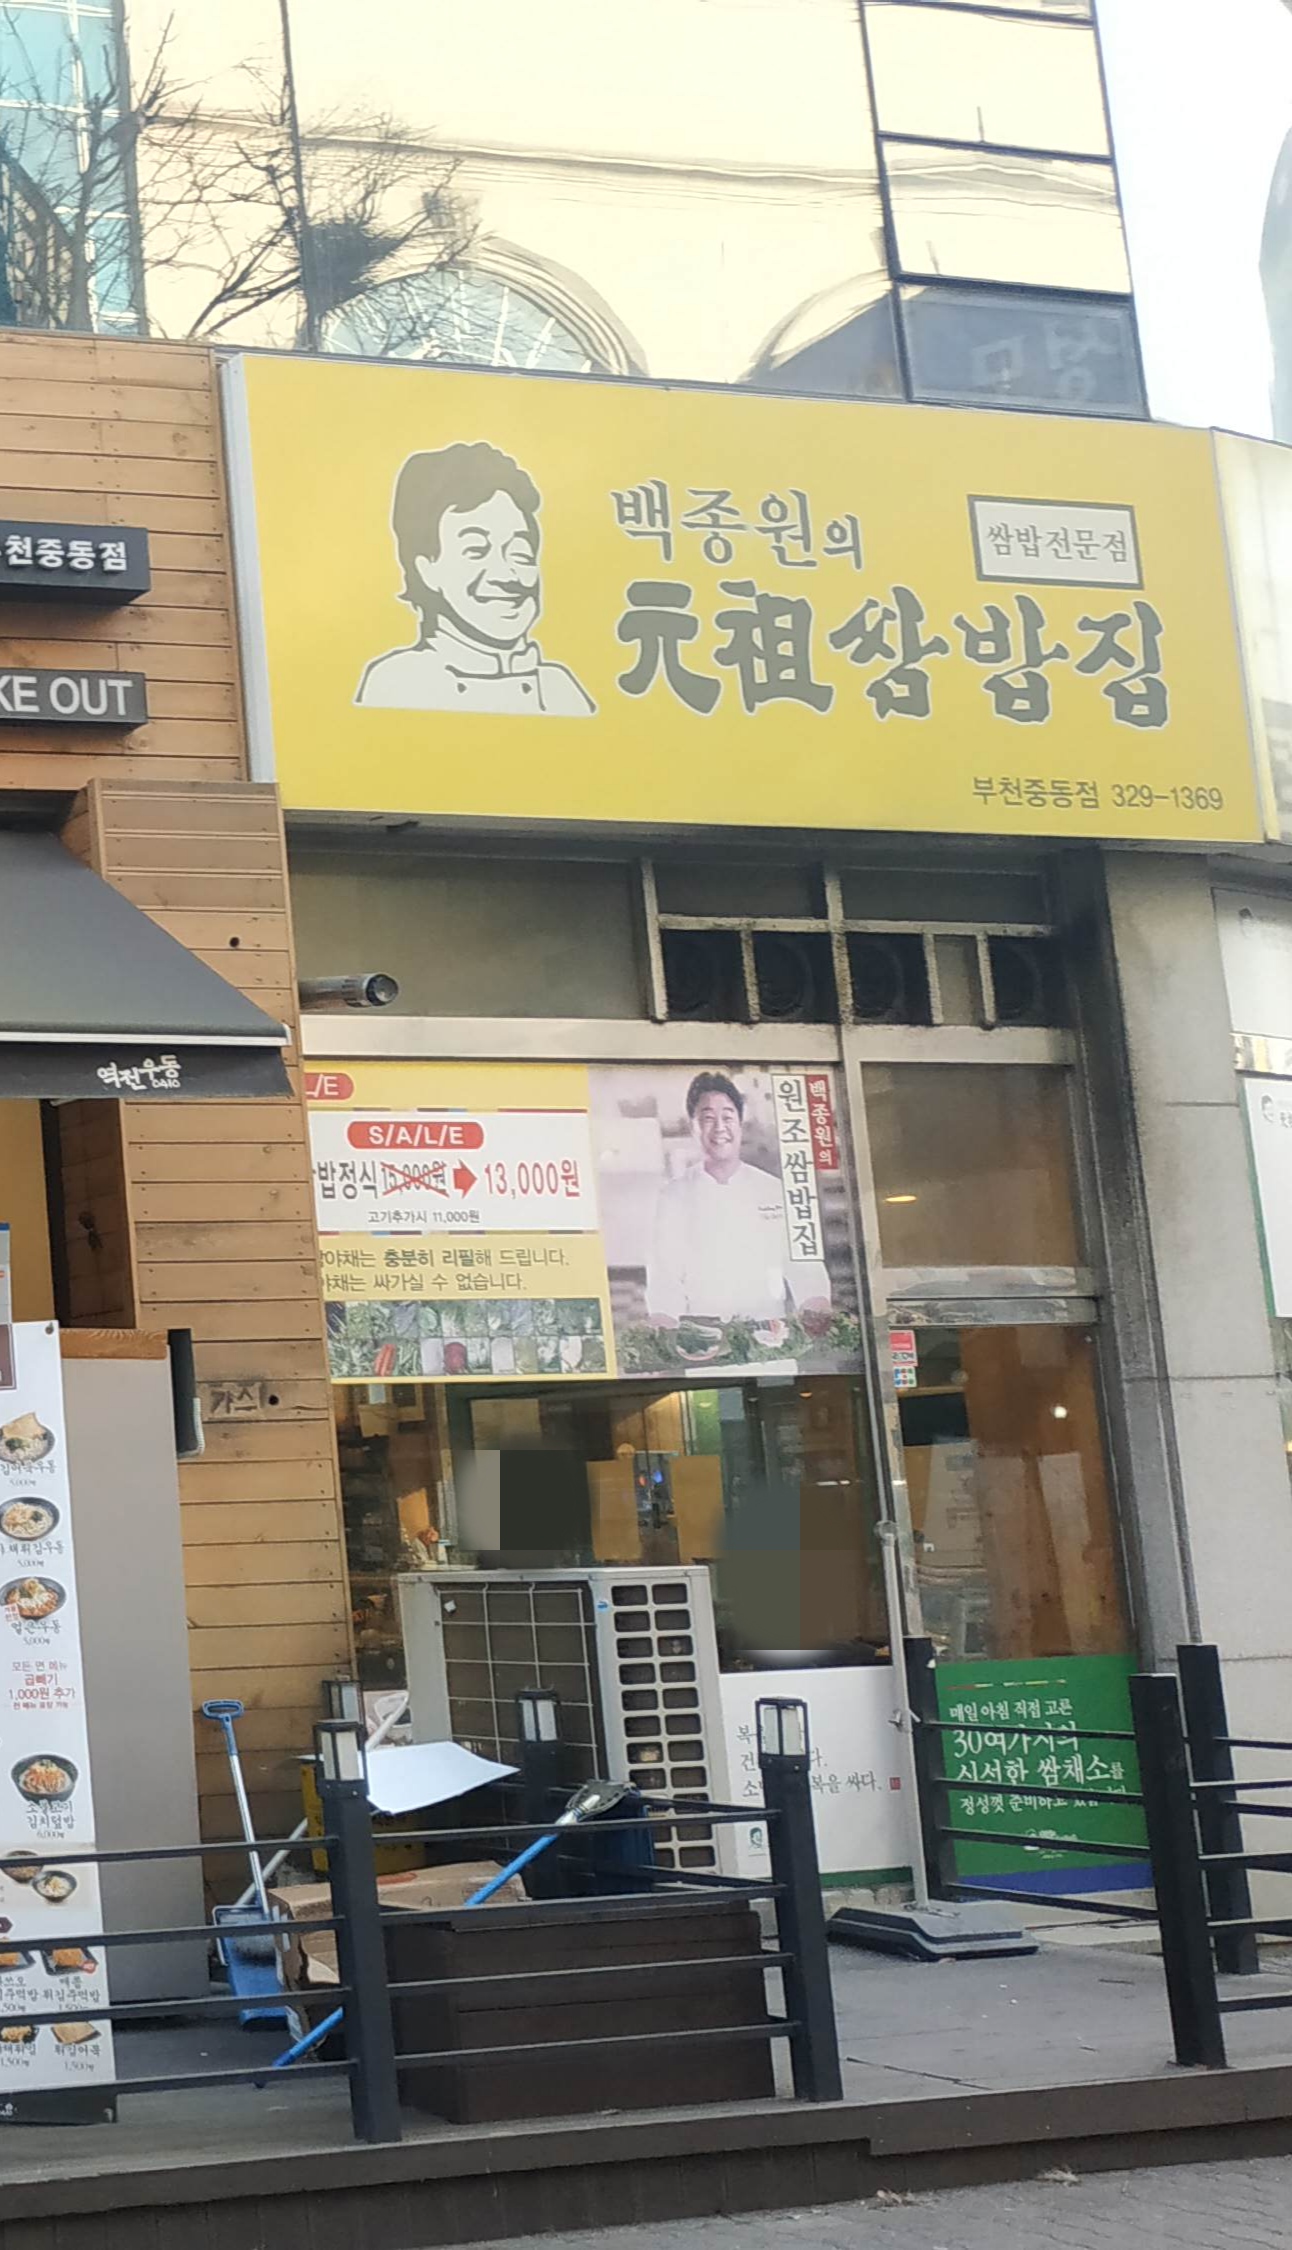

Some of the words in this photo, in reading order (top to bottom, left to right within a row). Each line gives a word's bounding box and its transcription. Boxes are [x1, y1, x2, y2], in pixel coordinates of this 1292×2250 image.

[612, 480, 862, 570] 백종원의
[0, 534, 128, 573] 천중동점
[986, 523, 1130, 564] 쌈밥전문점
[616, 578, 1170, 730] 元祖쌈밥집
[50, 677, 133, 717] OUT
[972, 776, 1100, 809] 부천중동점
[1111, 783, 1223, 811] 329-1369
[97, 1055, 181, 1091] 역전우동
[368, 1124, 465, 1146] S/A/L/E
[809, 1080, 832, 1165] 백종원의
[312, 1160, 378, 1199] 밥정식
[485, 1160, 581, 1198] 13,000원
[778, 1079, 818, 1257] 원조쌈밥집
[368, 1209, 428, 1224] 고기추가시
[433, 1210, 480, 1225] 11,000원
[383, 1248, 435, 1268] 충분히
[442, 1248, 492, 1268] 리필해
[500, 1248, 570, 1268] 드립니다.
[373, 1273, 424, 1292] 싸가실
[432, 1274, 449, 1291] 수
[456, 1274, 528, 1292] 없습니다.
[8, 1687, 50, 1700] 1,000원
[53, 1686, 76, 1700] 추가
[949, 1702, 979, 1722] 매일
[980, 1700, 1010, 1721] 아침
[1013, 1698, 1041, 1719] 직접
[1045, 1698, 1073, 1716] 고른
[847, 1770, 882, 1792] 싸다.
[1037, 1753, 1124, 1787] 쌈채소를
[960, 1795, 1005, 1815] 정성껏
